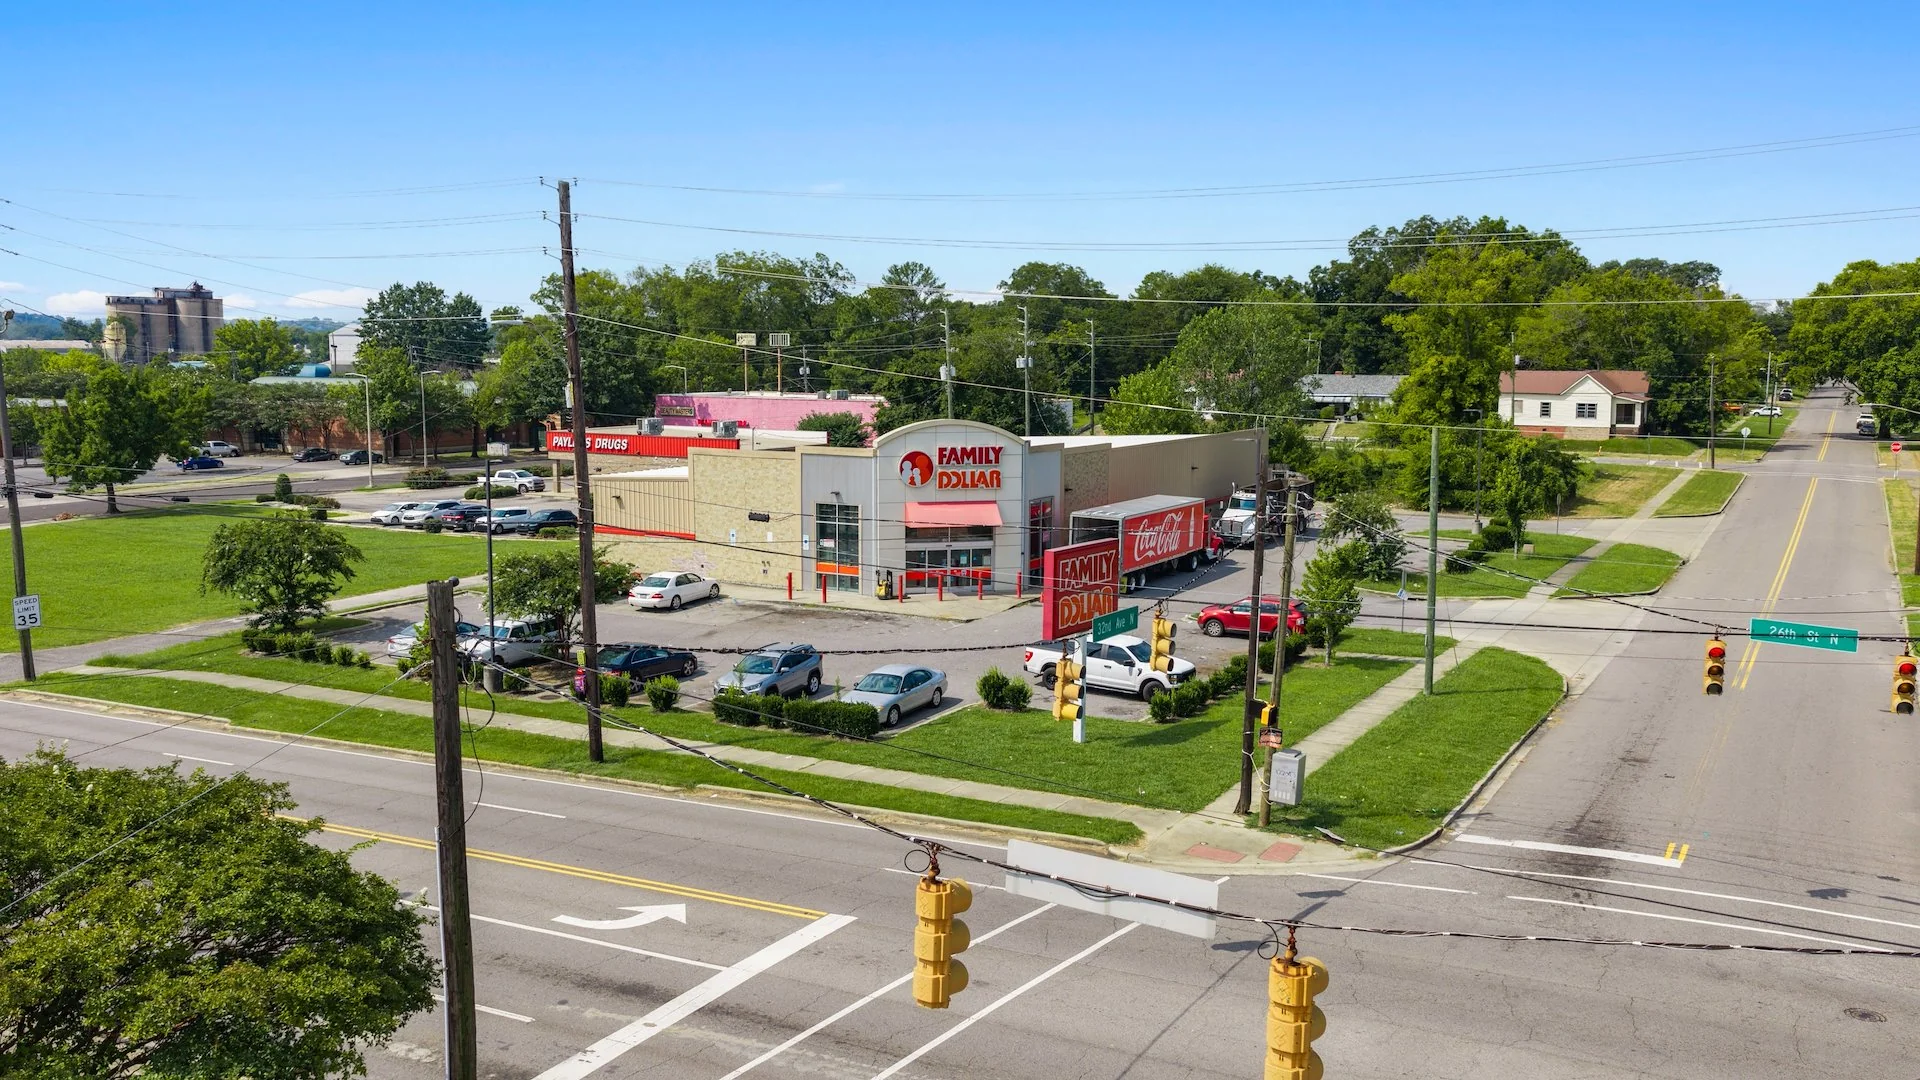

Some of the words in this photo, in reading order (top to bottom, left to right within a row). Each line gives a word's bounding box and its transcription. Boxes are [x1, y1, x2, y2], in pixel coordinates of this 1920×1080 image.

[595, 438, 628, 450] DRUGS
[937, 446, 1004, 465] FAMILY
[937, 470, 1002, 489] DOLLAR
[1059, 550, 1116, 592] FAMILY
[14, 598, 38, 606] SPEED
[1059, 586, 1113, 630] DOLLAR
[18, 614, 38, 626] 35
[1097, 620, 1112, 635] 32nd
[1116, 617, 1126, 629] Ave
[1129, 613, 1135, 625] N
[1769, 625, 1796, 640] 26th
[1806, 630, 1819, 643] St
[1830, 633, 1839, 645] N
